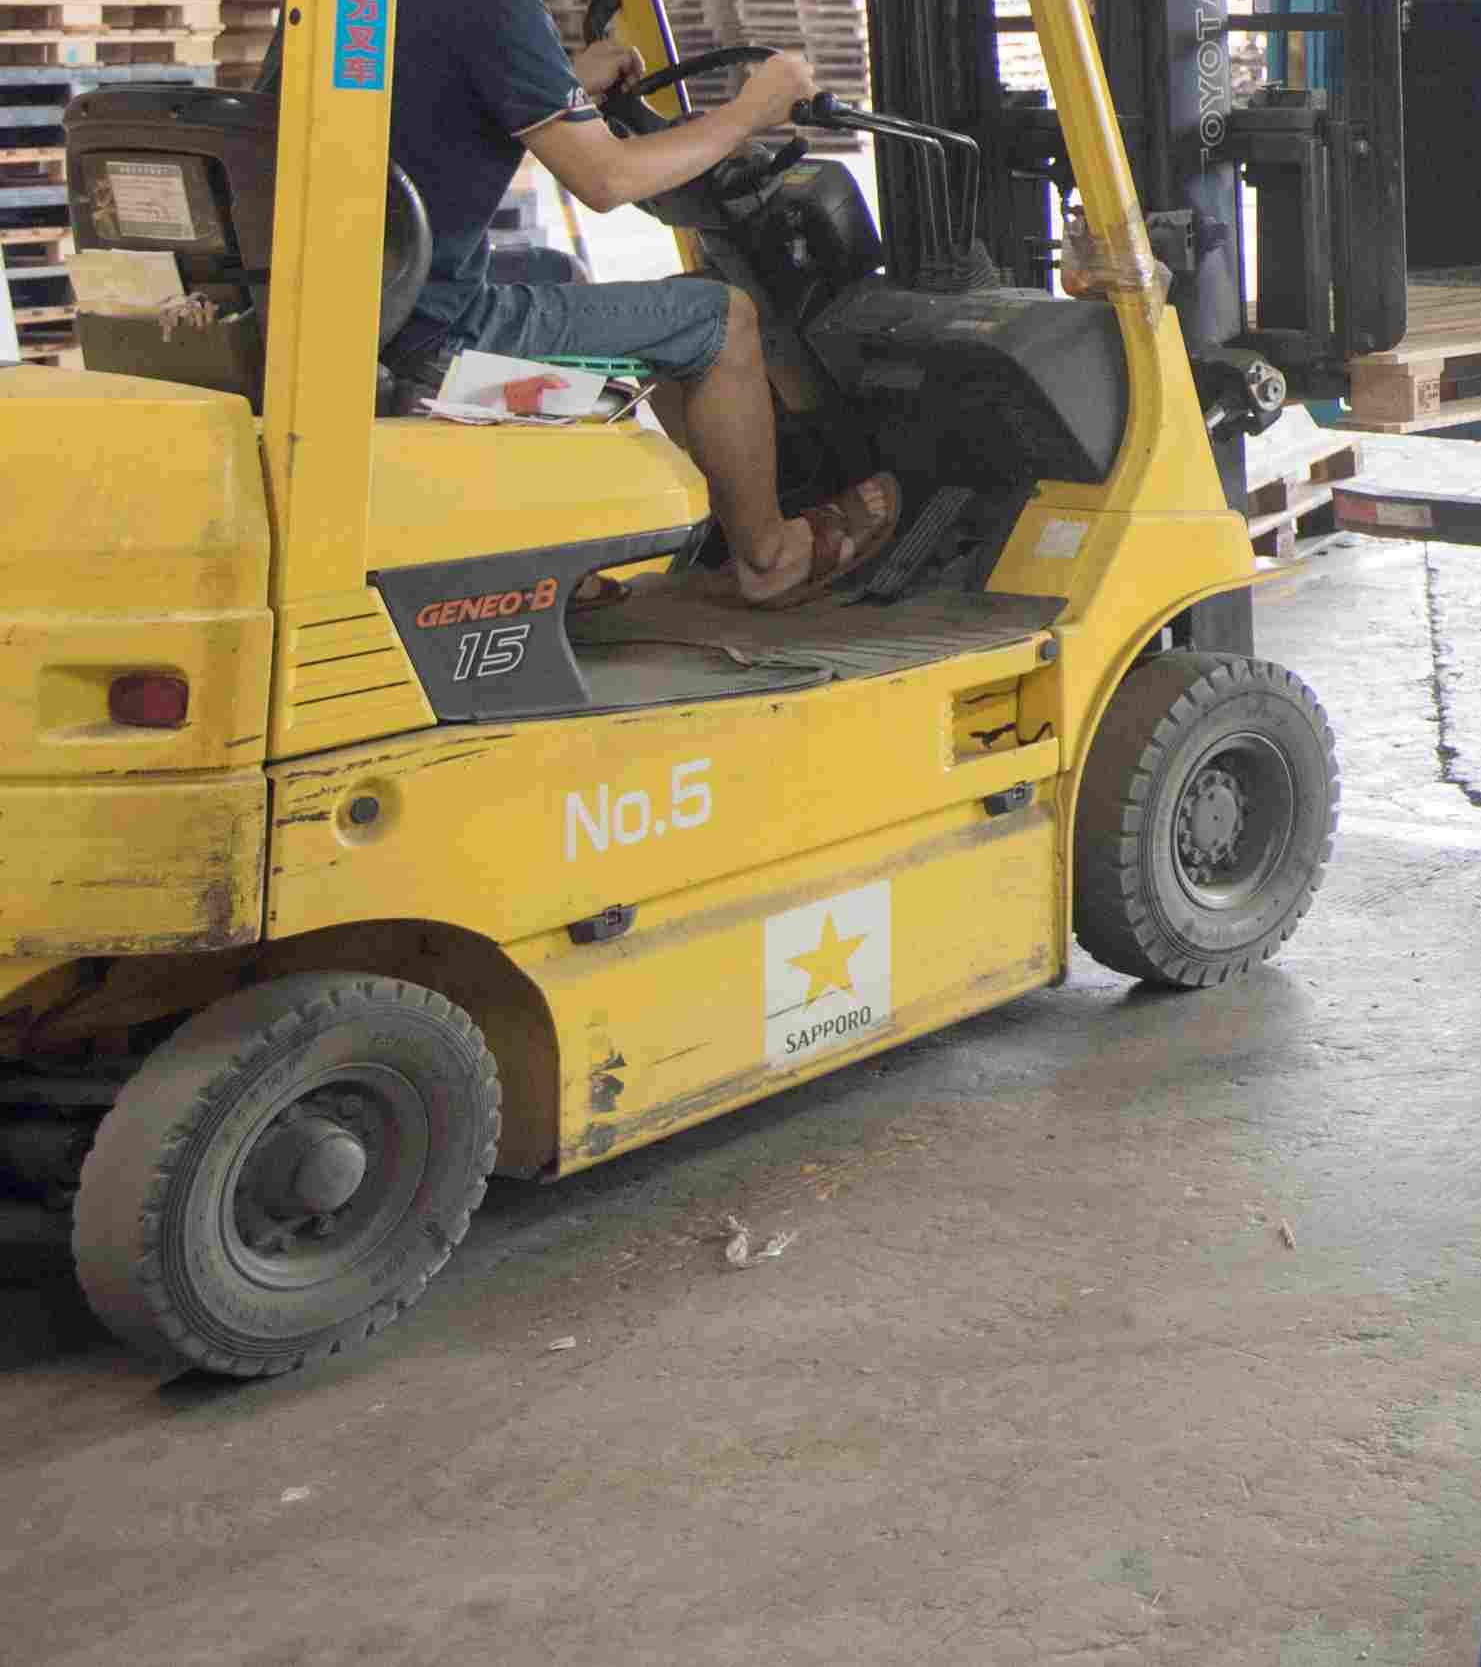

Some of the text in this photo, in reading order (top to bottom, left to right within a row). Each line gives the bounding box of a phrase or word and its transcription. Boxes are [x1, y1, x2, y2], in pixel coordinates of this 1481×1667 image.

[453, 624, 531, 681] 15
[564, 757, 713, 862] No.5
[784, 1005, 873, 1055] SAPPORO
